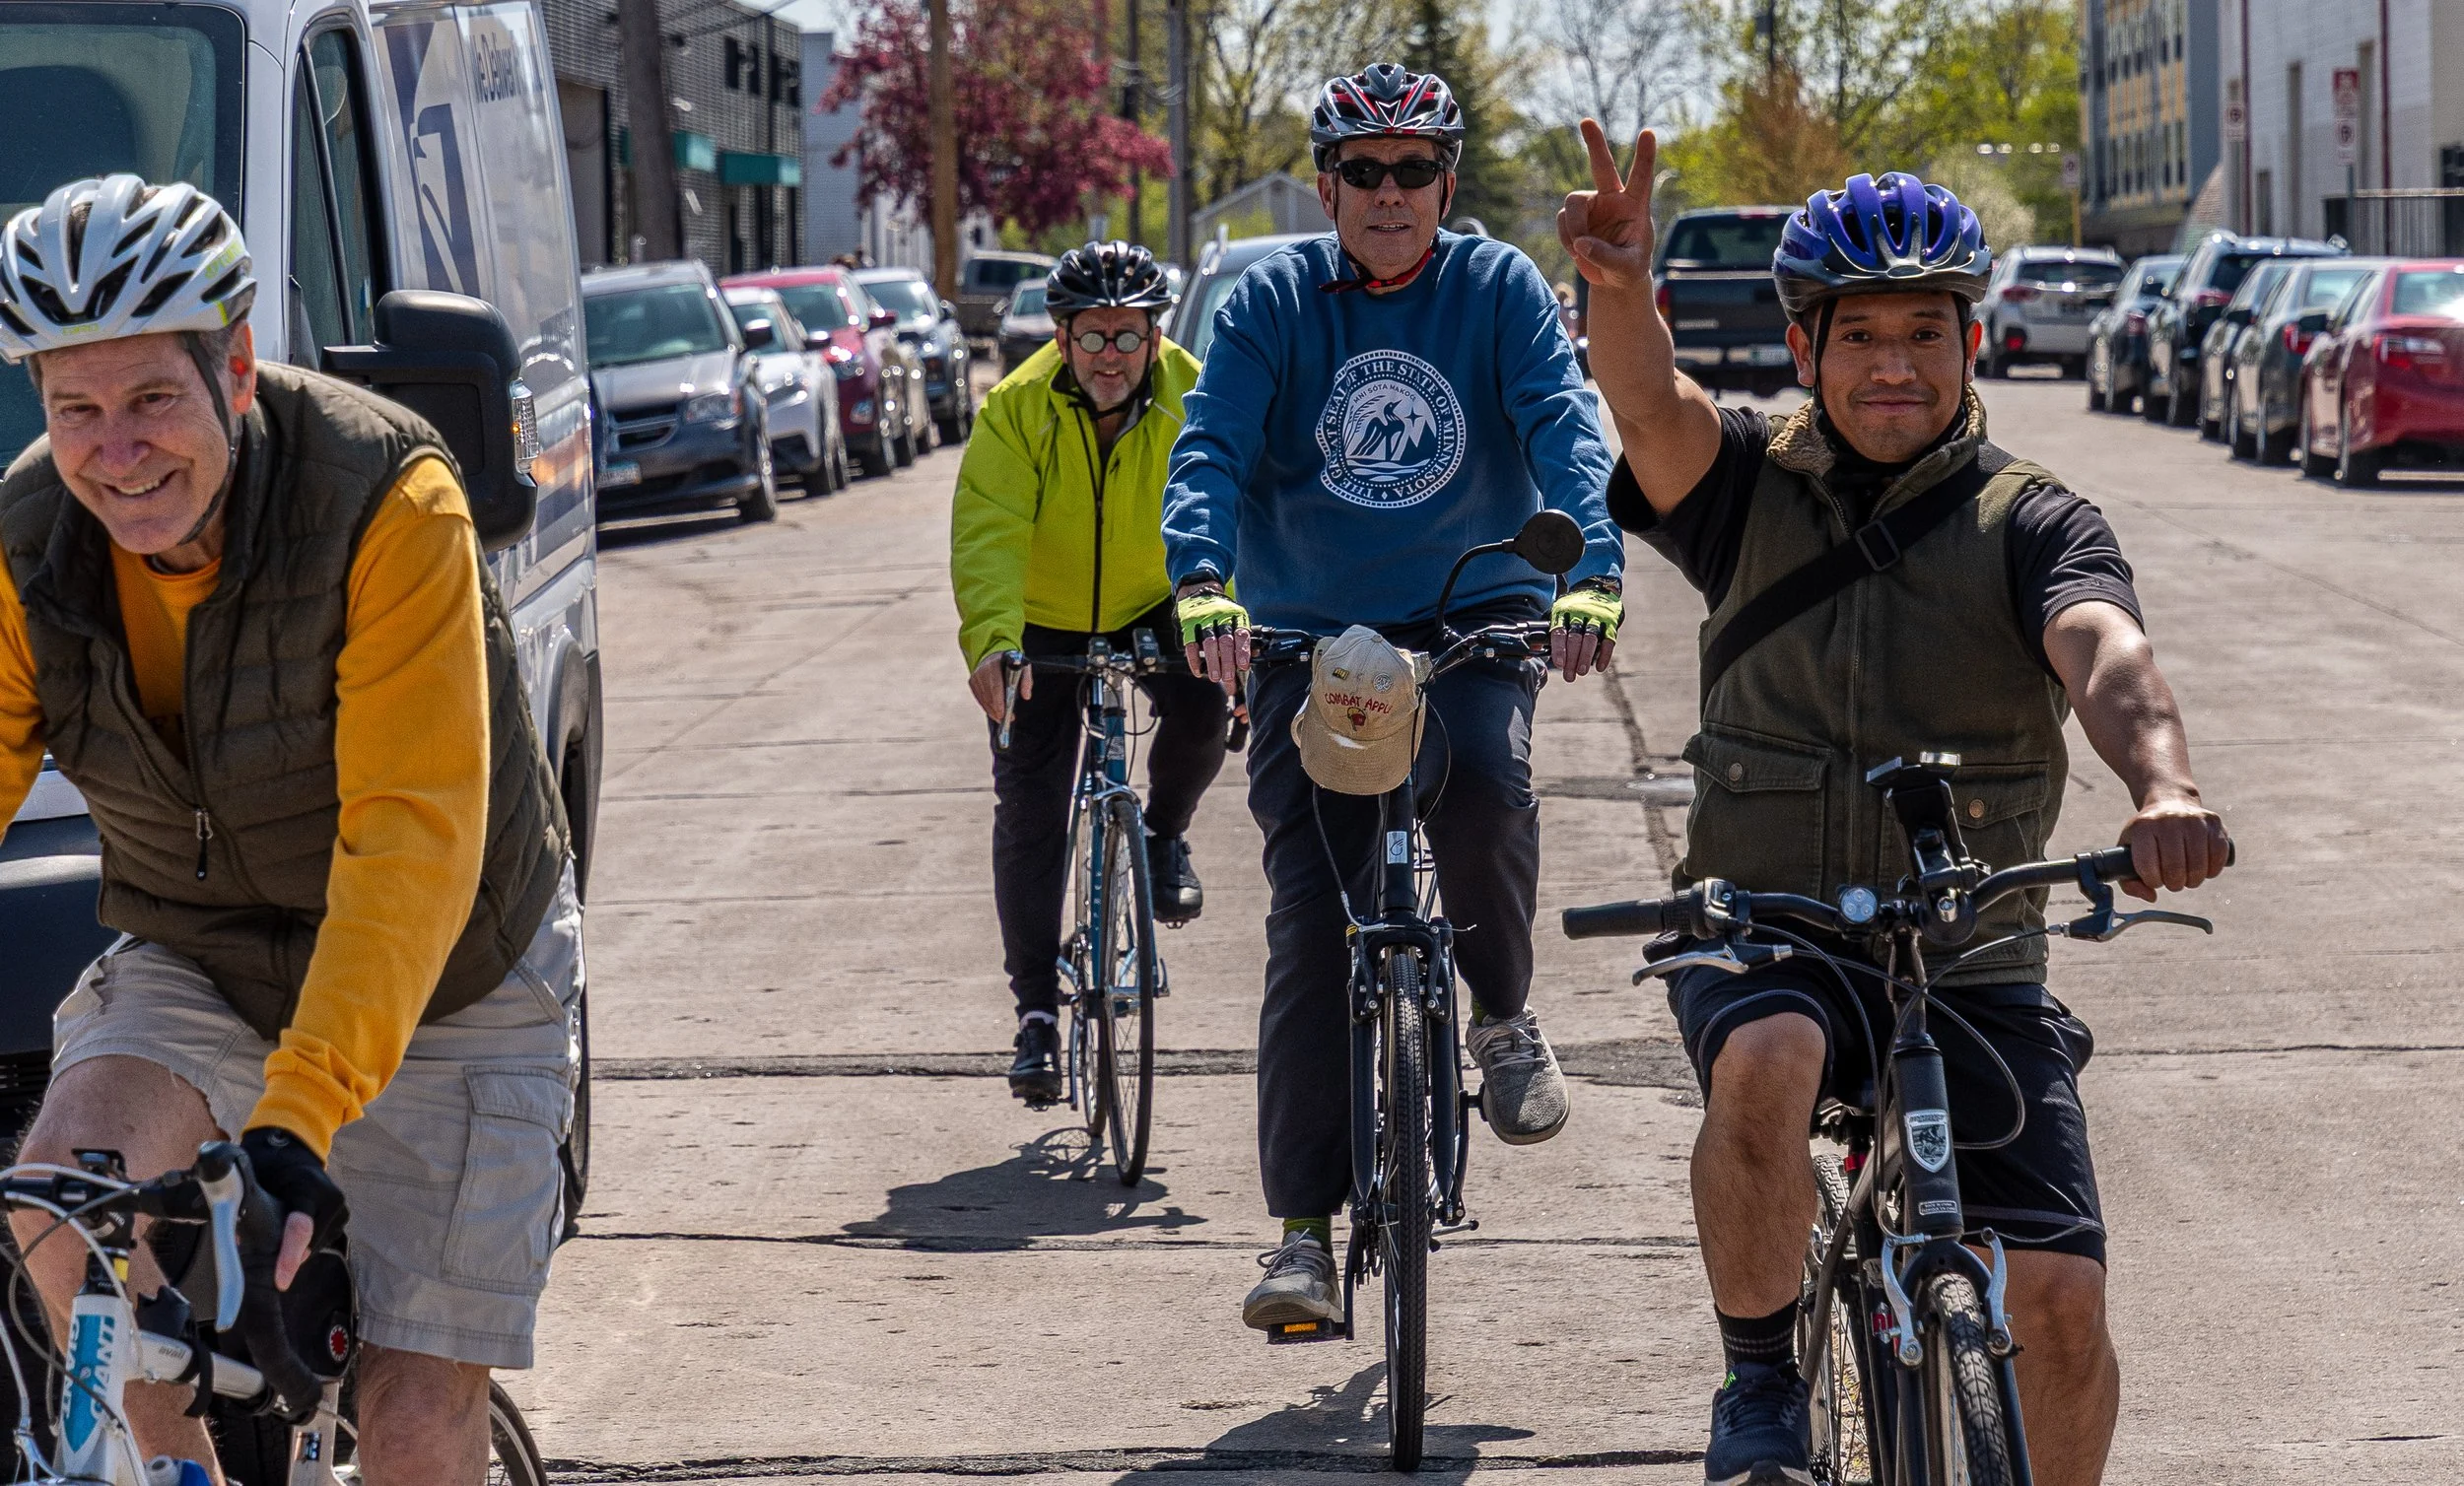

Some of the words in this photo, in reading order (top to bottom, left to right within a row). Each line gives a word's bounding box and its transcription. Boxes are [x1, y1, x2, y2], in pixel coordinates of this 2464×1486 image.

[1360, 361, 1395, 375] THE
[1345, 370, 1357, 387] OF
[1398, 364, 1438, 396] STATE
[1326, 385, 1347, 425] SEAL
[1353, 391, 1367, 403] MNI
[1435, 395, 1451, 415] OF
[1392, 419, 1455, 498] MINNESOTA
[1339, 478, 1374, 499] THE
[1325, 693, 1362, 707] COMBAT
[90, 1316, 115, 1420] GIANT
